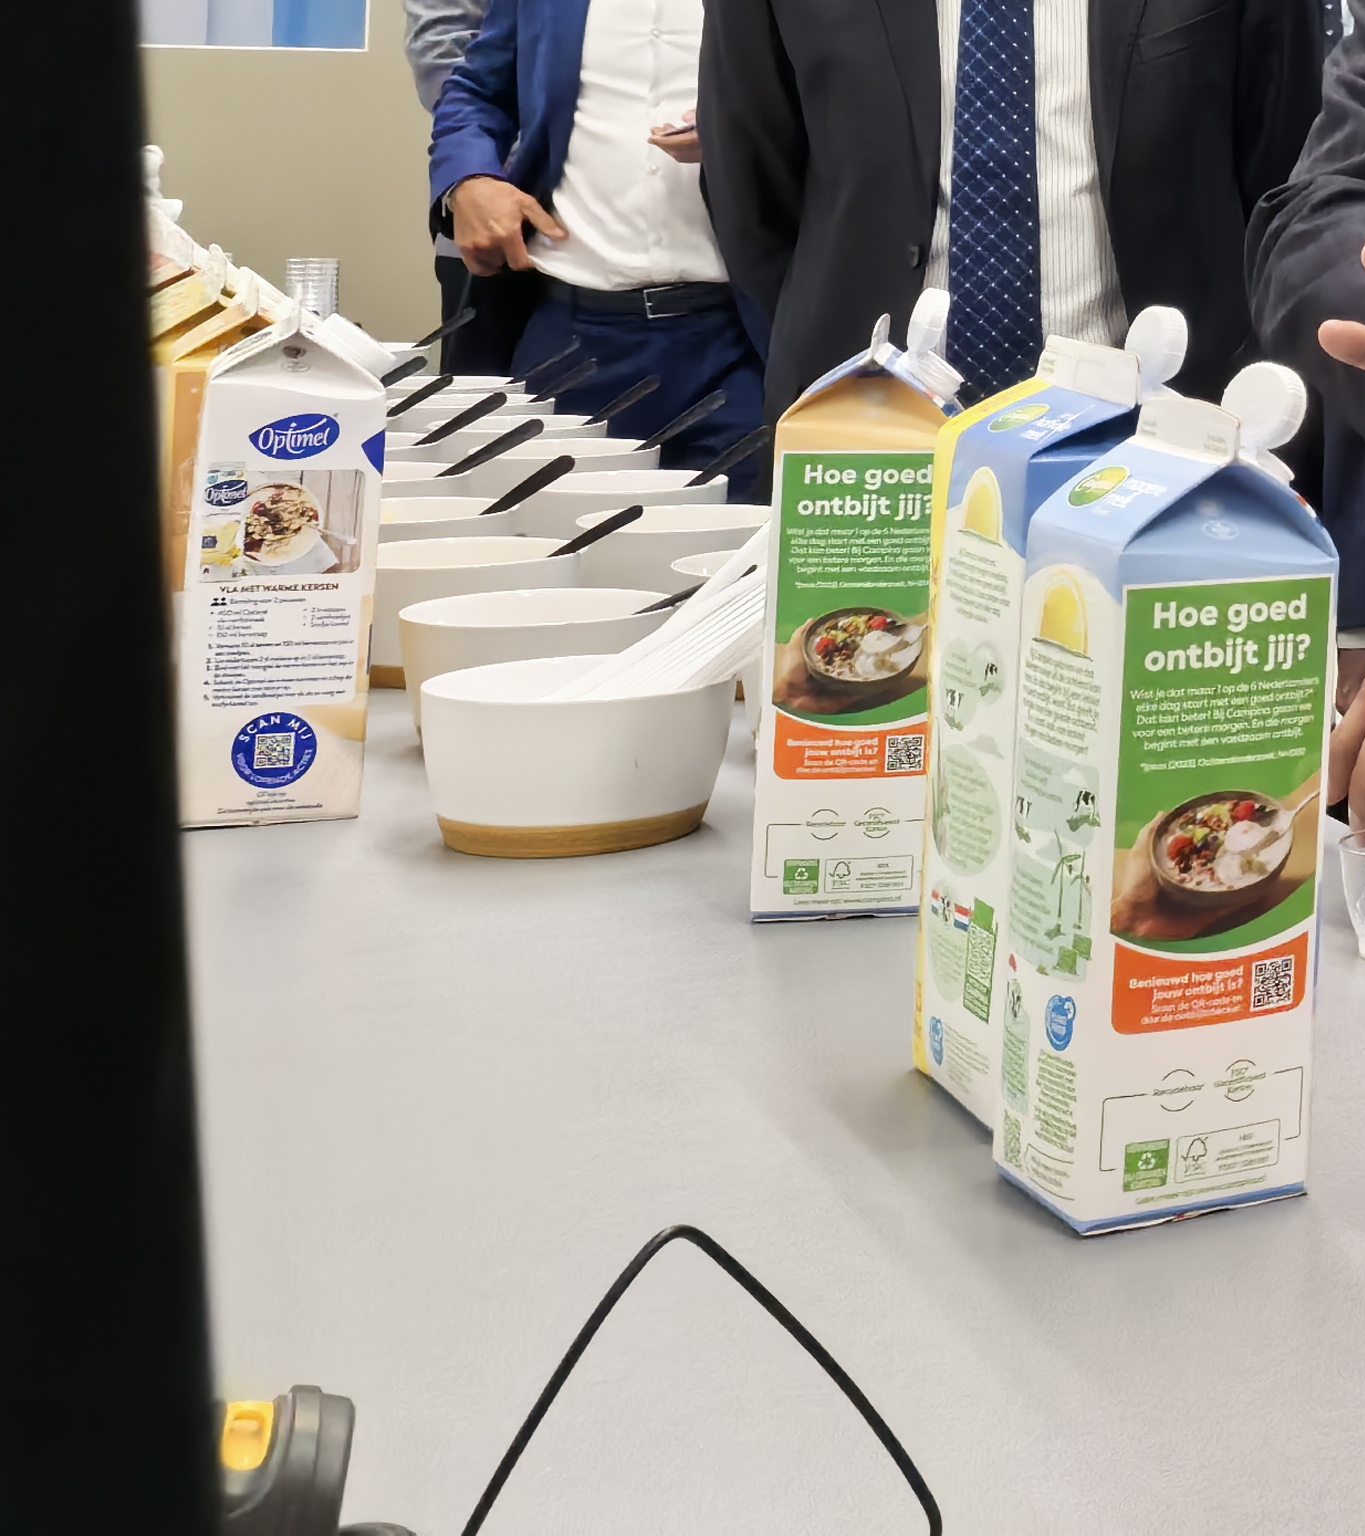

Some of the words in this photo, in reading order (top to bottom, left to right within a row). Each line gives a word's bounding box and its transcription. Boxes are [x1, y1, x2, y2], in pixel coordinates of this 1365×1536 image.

[258, 420, 331, 455] Optimel
[803, 464, 857, 484] Hoe
[864, 464, 933, 490] goed
[797, 494, 891, 521] ontbijt
[894, 493, 932, 521] jij?
[1153, 601, 1218, 629] Hoe
[1227, 592, 1307, 632] goed
[1144, 637, 1259, 674] ontbijt
[1263, 633, 1311, 672] jij?
[239, 715, 281, 742] SCAN
[287, 718, 312, 740] MIJ
